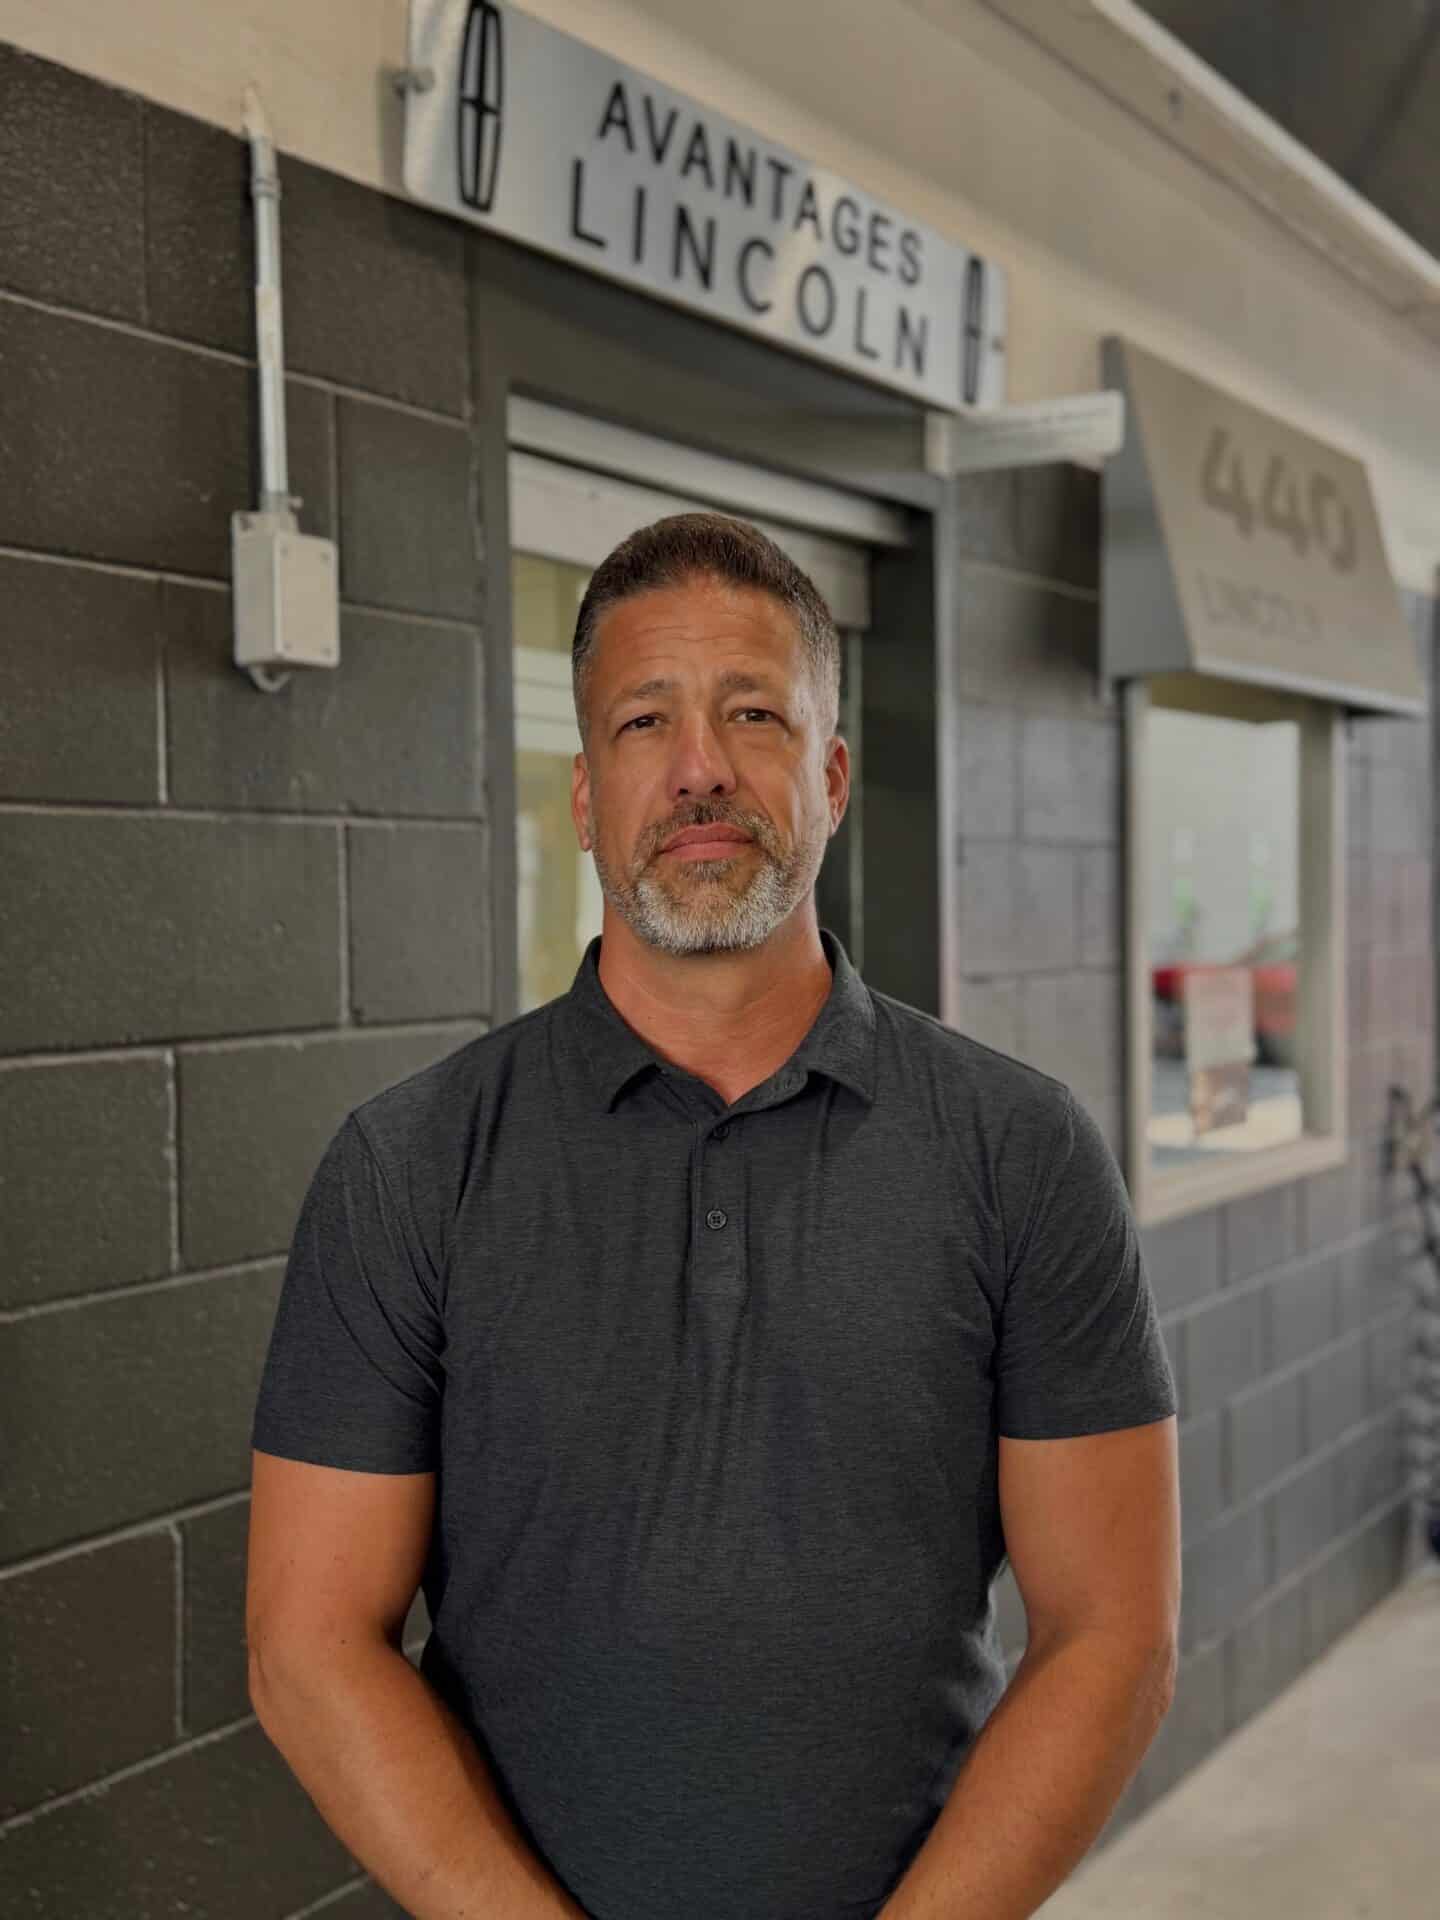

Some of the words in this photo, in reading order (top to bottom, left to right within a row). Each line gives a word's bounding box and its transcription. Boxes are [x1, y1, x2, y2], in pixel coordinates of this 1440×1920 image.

[571, 158, 927, 378] LINCOLN
[599, 82, 923, 286] AVANTAGES
[1202, 427, 1356, 573] 440
